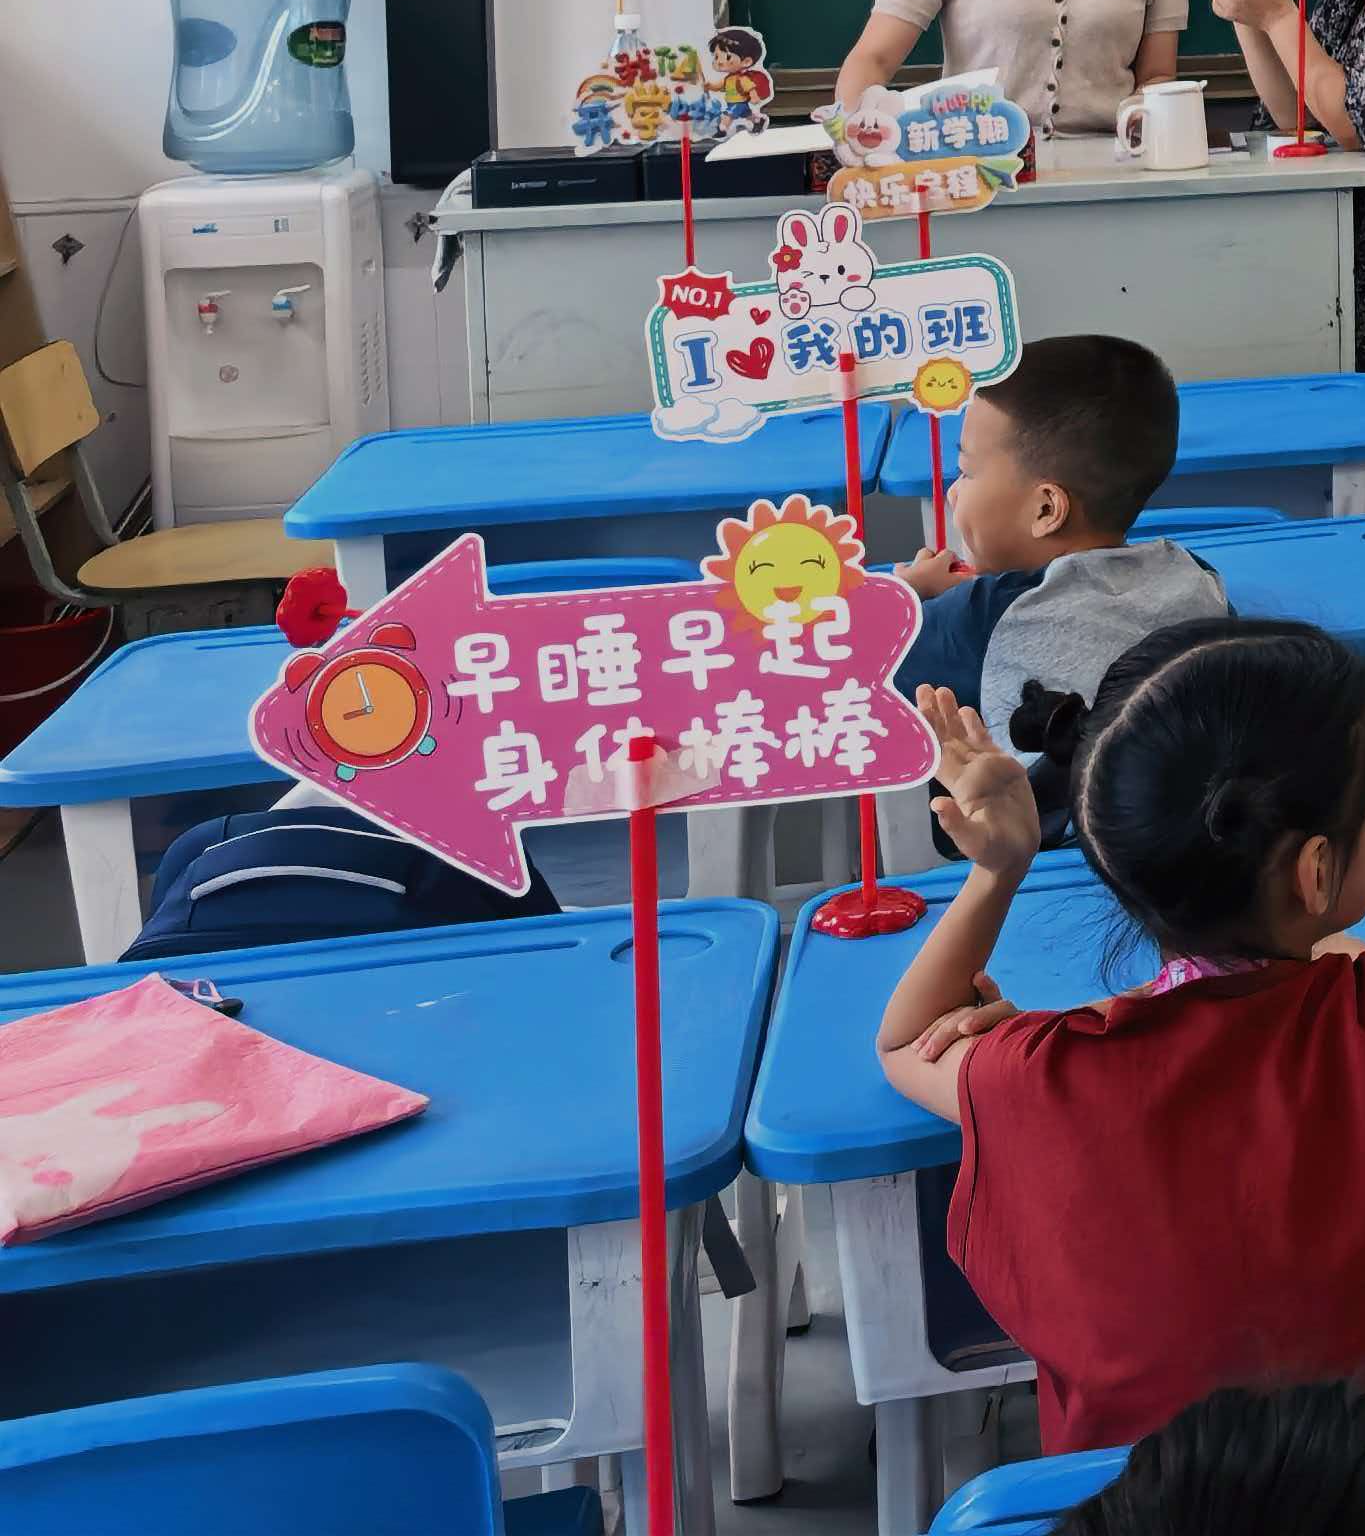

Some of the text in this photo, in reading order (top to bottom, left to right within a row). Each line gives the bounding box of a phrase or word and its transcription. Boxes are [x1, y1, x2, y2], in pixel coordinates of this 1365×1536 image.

[906, 114, 1009, 152] 新学期
[671, 284, 723, 310] NO.1
[682, 304, 990, 389] I 我的班
[447, 595, 852, 714] 早睡早起
[474, 679, 889, 812] 身体棒棒
